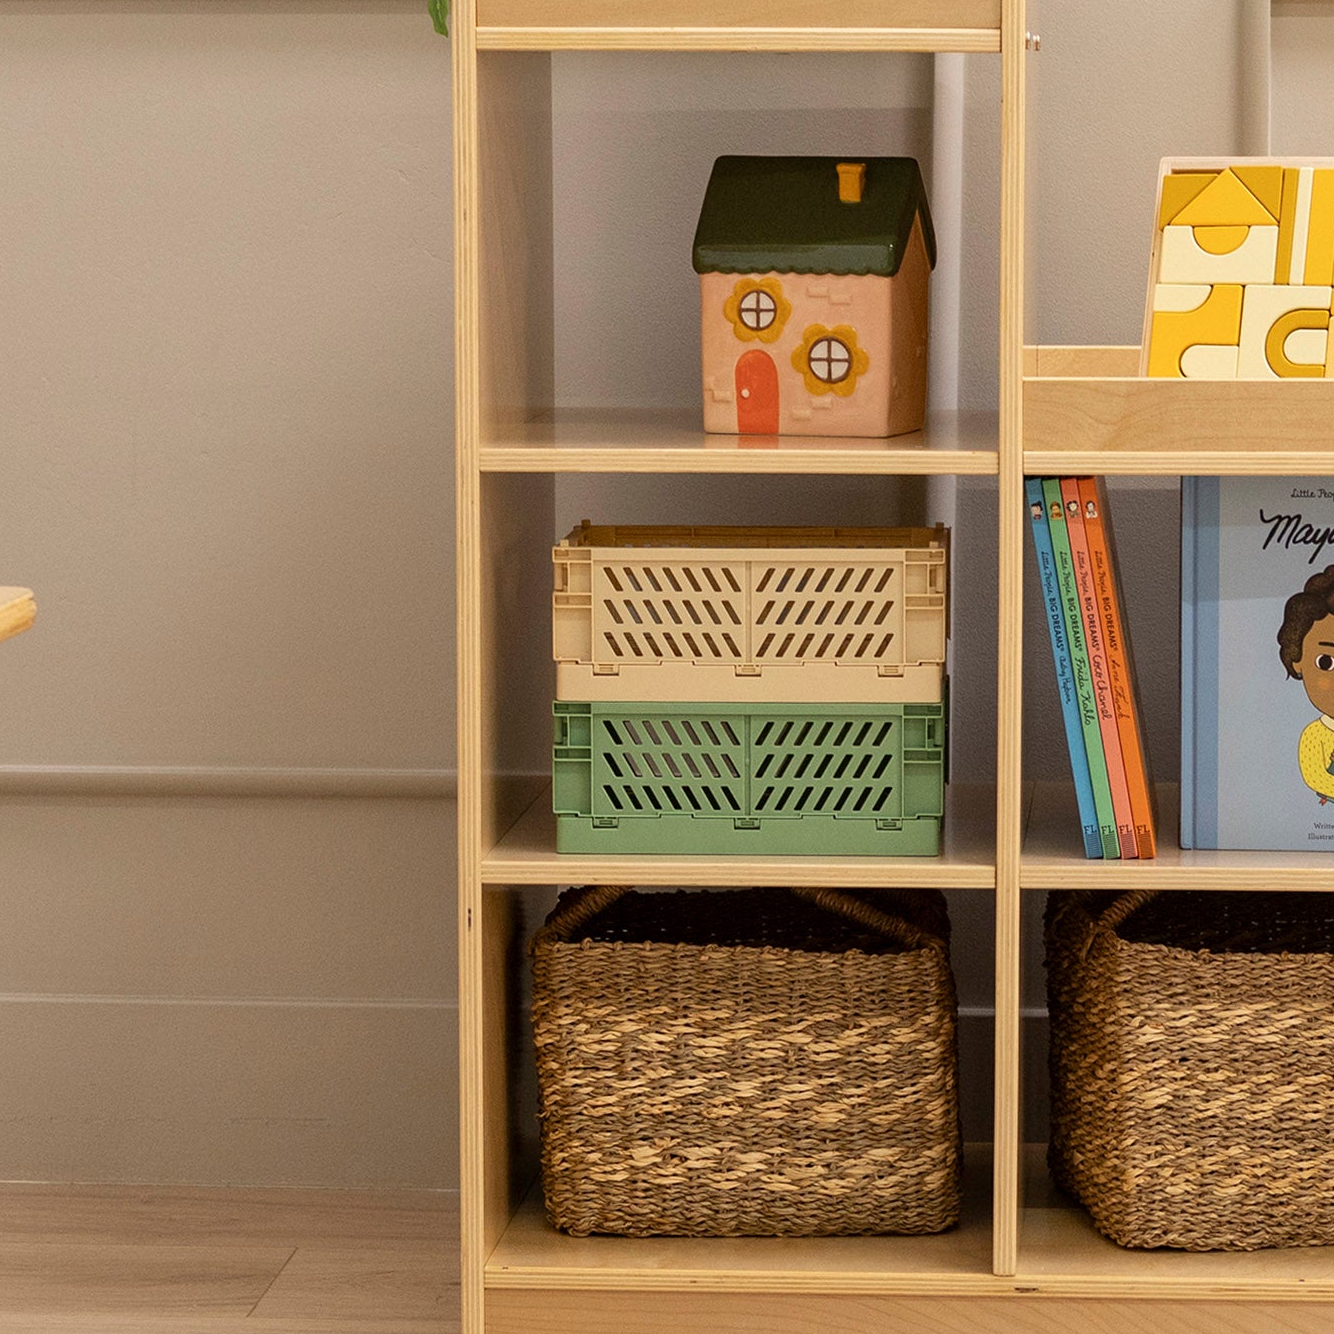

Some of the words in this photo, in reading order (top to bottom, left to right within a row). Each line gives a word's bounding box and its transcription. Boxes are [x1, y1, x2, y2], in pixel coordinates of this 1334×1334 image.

[1290, 488, 1316, 499] Little
[1049, 597, 1058, 612] BIG
[1067, 597, 1076, 612] BIG
[1084, 597, 1094, 612] BIG
[1102, 597, 1111, 612] BIG
[1075, 656, 1089, 690] Frida
[1092, 654, 1103, 679] Coco
[1096, 679, 1113, 720] Chanel
[1080, 690, 1095, 726] Kahlo
[1083, 824, 1098, 835] FL
[1101, 824, 1115, 835] FL
[1118, 824, 1133, 835] FL
[1136, 824, 1151, 835] FL
